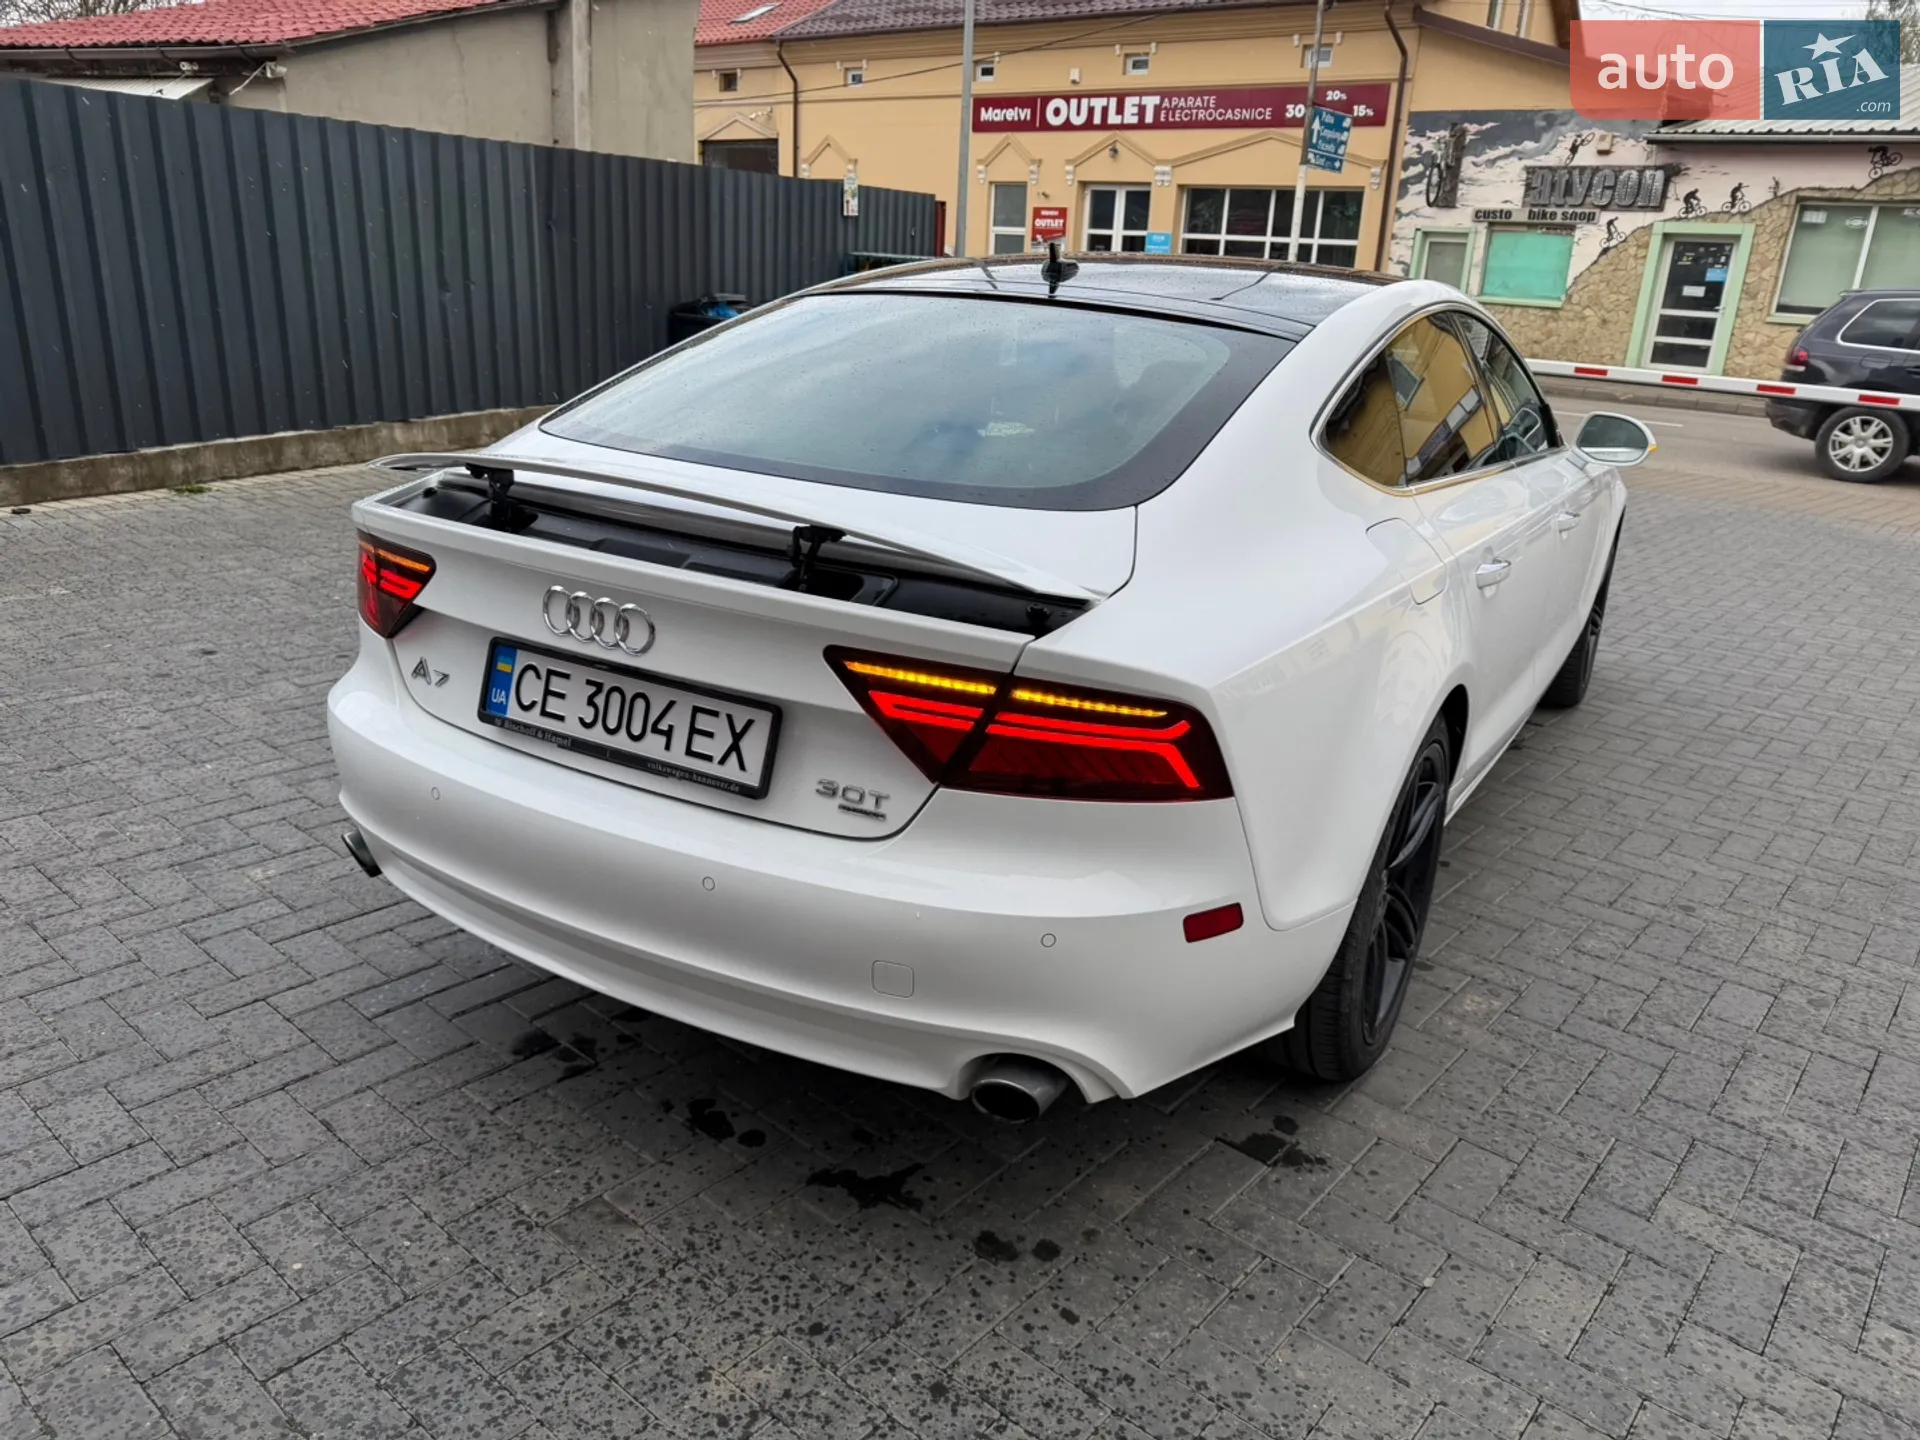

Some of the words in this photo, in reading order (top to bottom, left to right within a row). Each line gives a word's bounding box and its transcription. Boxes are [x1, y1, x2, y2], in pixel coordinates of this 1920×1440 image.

[1161, 96, 1216, 108] APARATE
[1326, 90, 1347, 101] 20%
[980, 106, 1031, 122] Marelvi
[1045, 95, 1160, 126] OUTLET
[1160, 107, 1272, 122] ELECTROCASNICE
[1285, 104, 1305, 118] 30
[1353, 105, 1374, 117] 15%
[1527, 208, 1557, 221] bike
[1034, 218, 1064, 227] OUTLET
[411, 656, 450, 687] A7
[491, 687, 507, 705] UA
[515, 663, 571, 722] CE
[578, 678, 677, 751] 3004
[684, 704, 755, 772] EX
